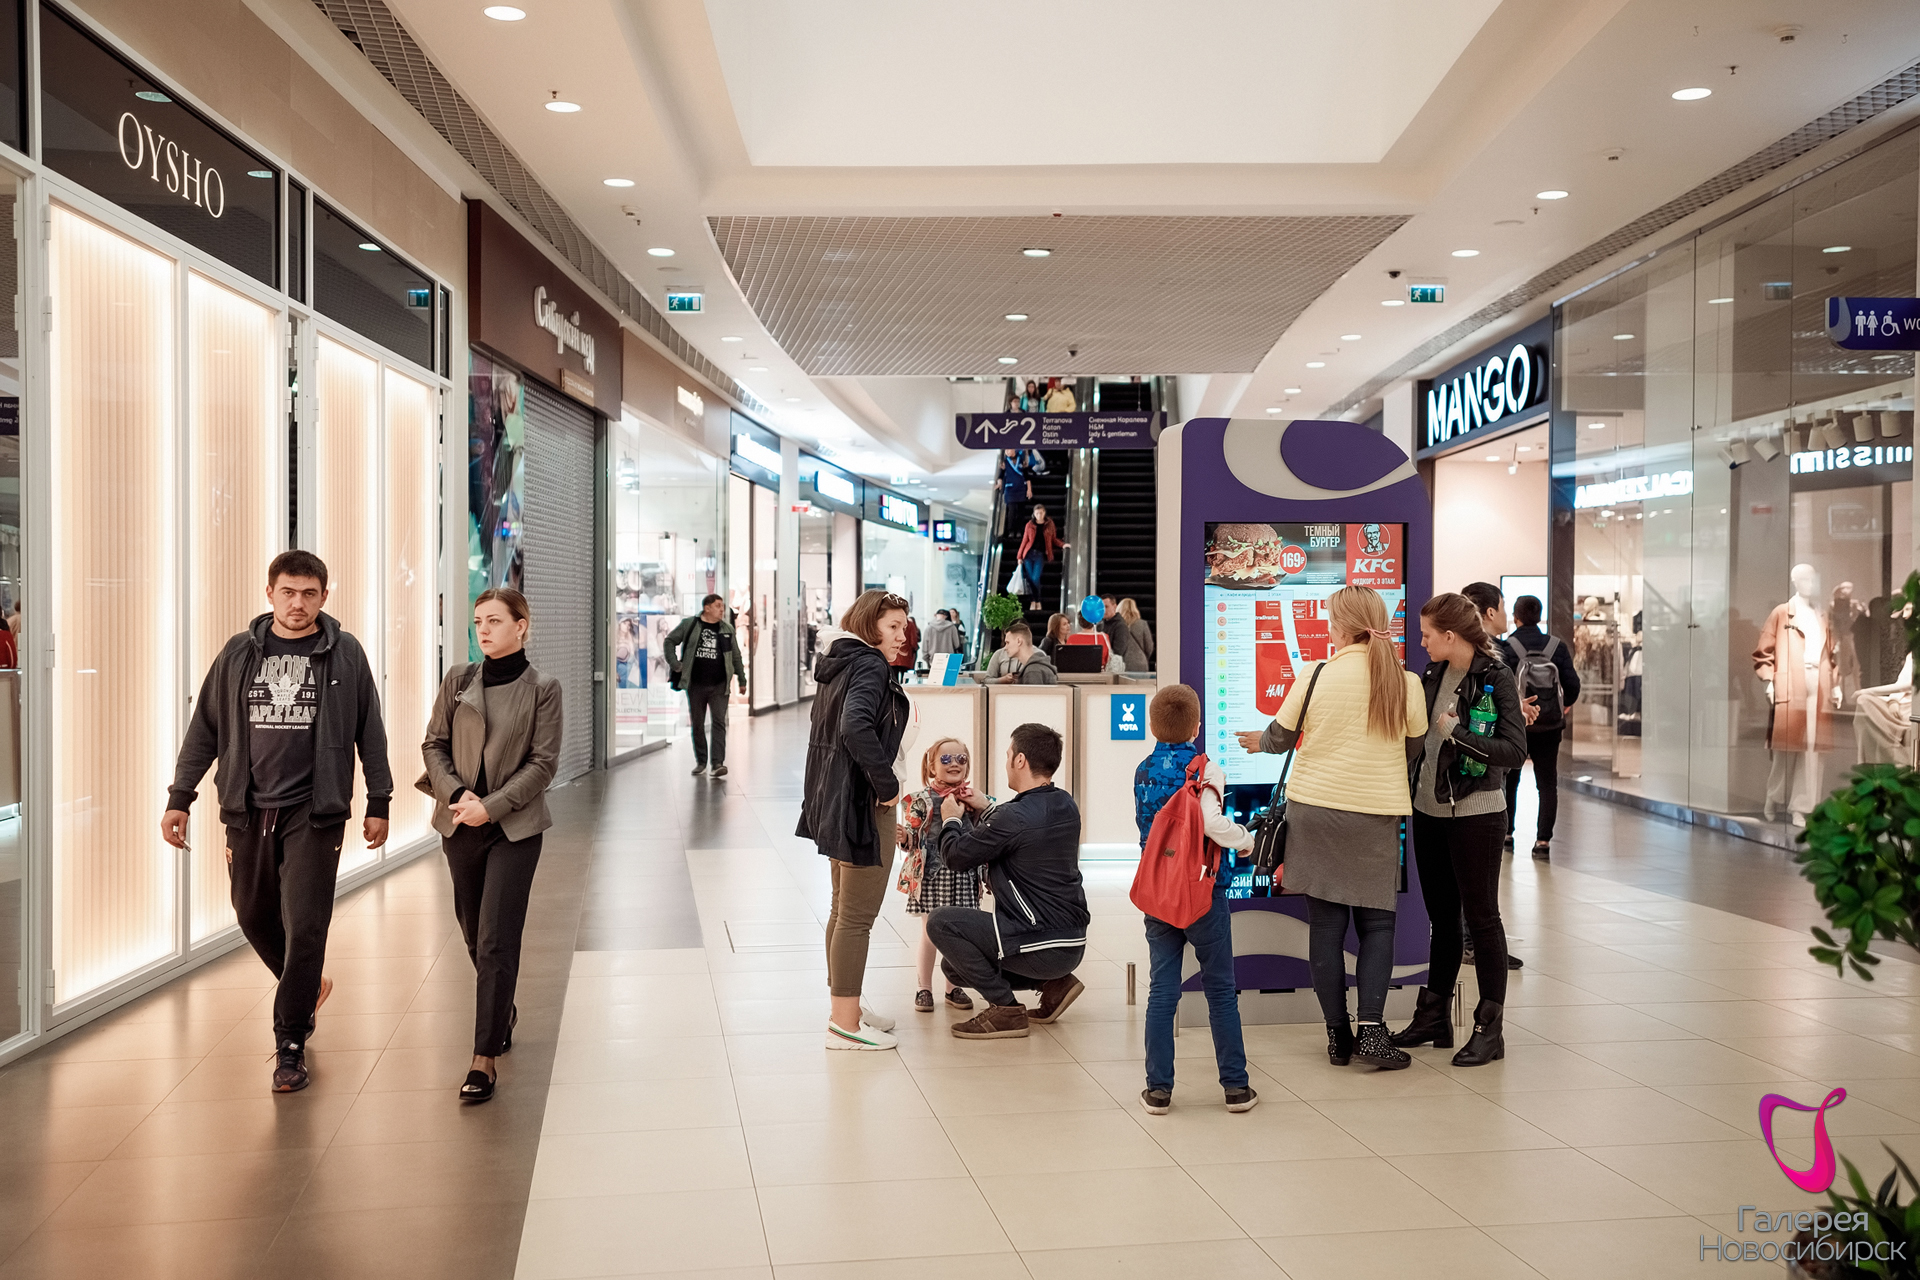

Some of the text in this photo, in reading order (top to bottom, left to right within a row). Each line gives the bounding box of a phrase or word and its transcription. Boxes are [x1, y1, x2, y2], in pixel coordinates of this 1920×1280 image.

[118, 112, 224, 218] OYSHO
[1427, 343, 1531, 447] MANGO
[1042, 416, 1073, 424] Terranova
[1088, 416, 1148, 424] Снежная Королева
[1020, 417, 1036, 445] 2
[1107, 430, 1138, 438] gentleman
[1304, 524, 1340, 537] ТЕМНЫЙ
[1310, 537, 1340, 548] БУРГЕР
[1352, 558, 1395, 573] KFC
[1381, 577, 1396, 585] ЭТАЖ
[248, 690, 317, 699] EST. 191
[1265, 684, 1285, 698] H&M
[1118, 723, 1139, 732] YOTA
